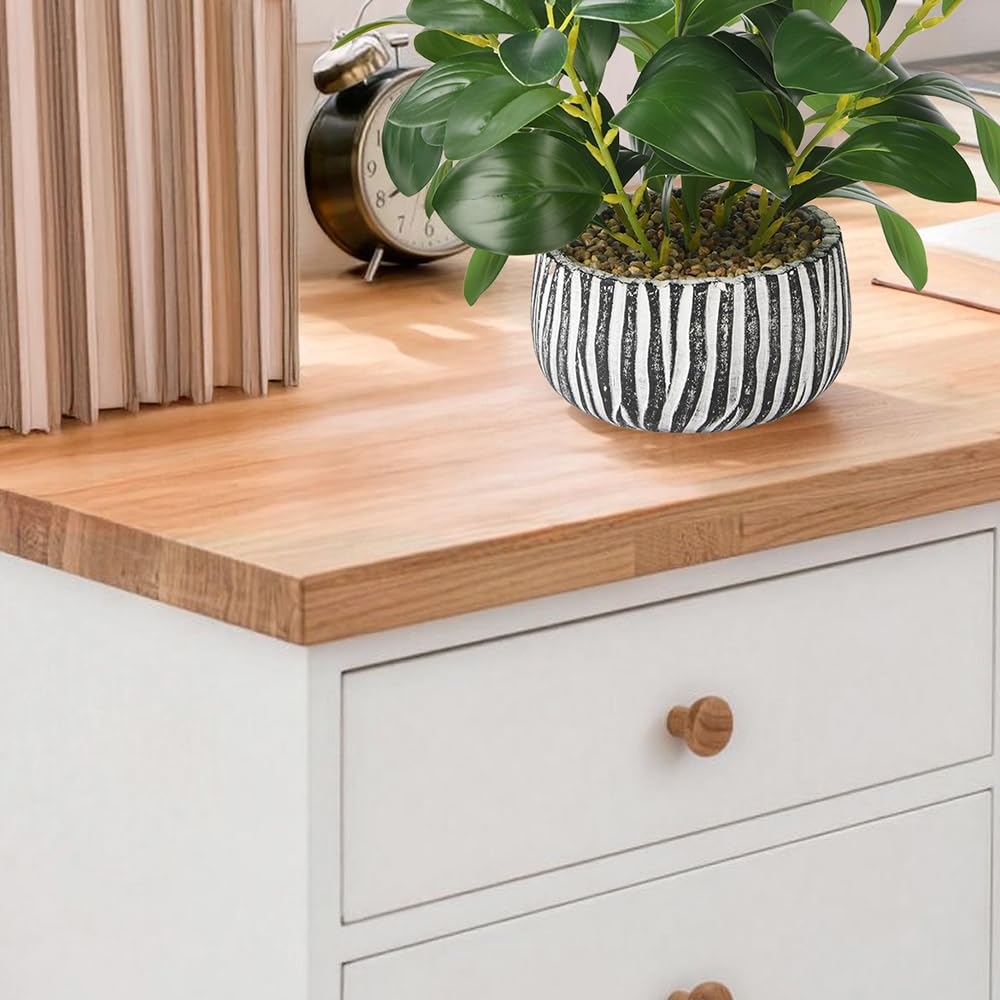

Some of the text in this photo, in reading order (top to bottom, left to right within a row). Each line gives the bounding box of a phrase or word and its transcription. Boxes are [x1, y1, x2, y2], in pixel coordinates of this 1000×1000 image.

[367, 160, 377, 178] 9
[375, 191, 386, 208] 8
[397, 215, 405, 233] 7
[425, 218, 435, 237] 6
